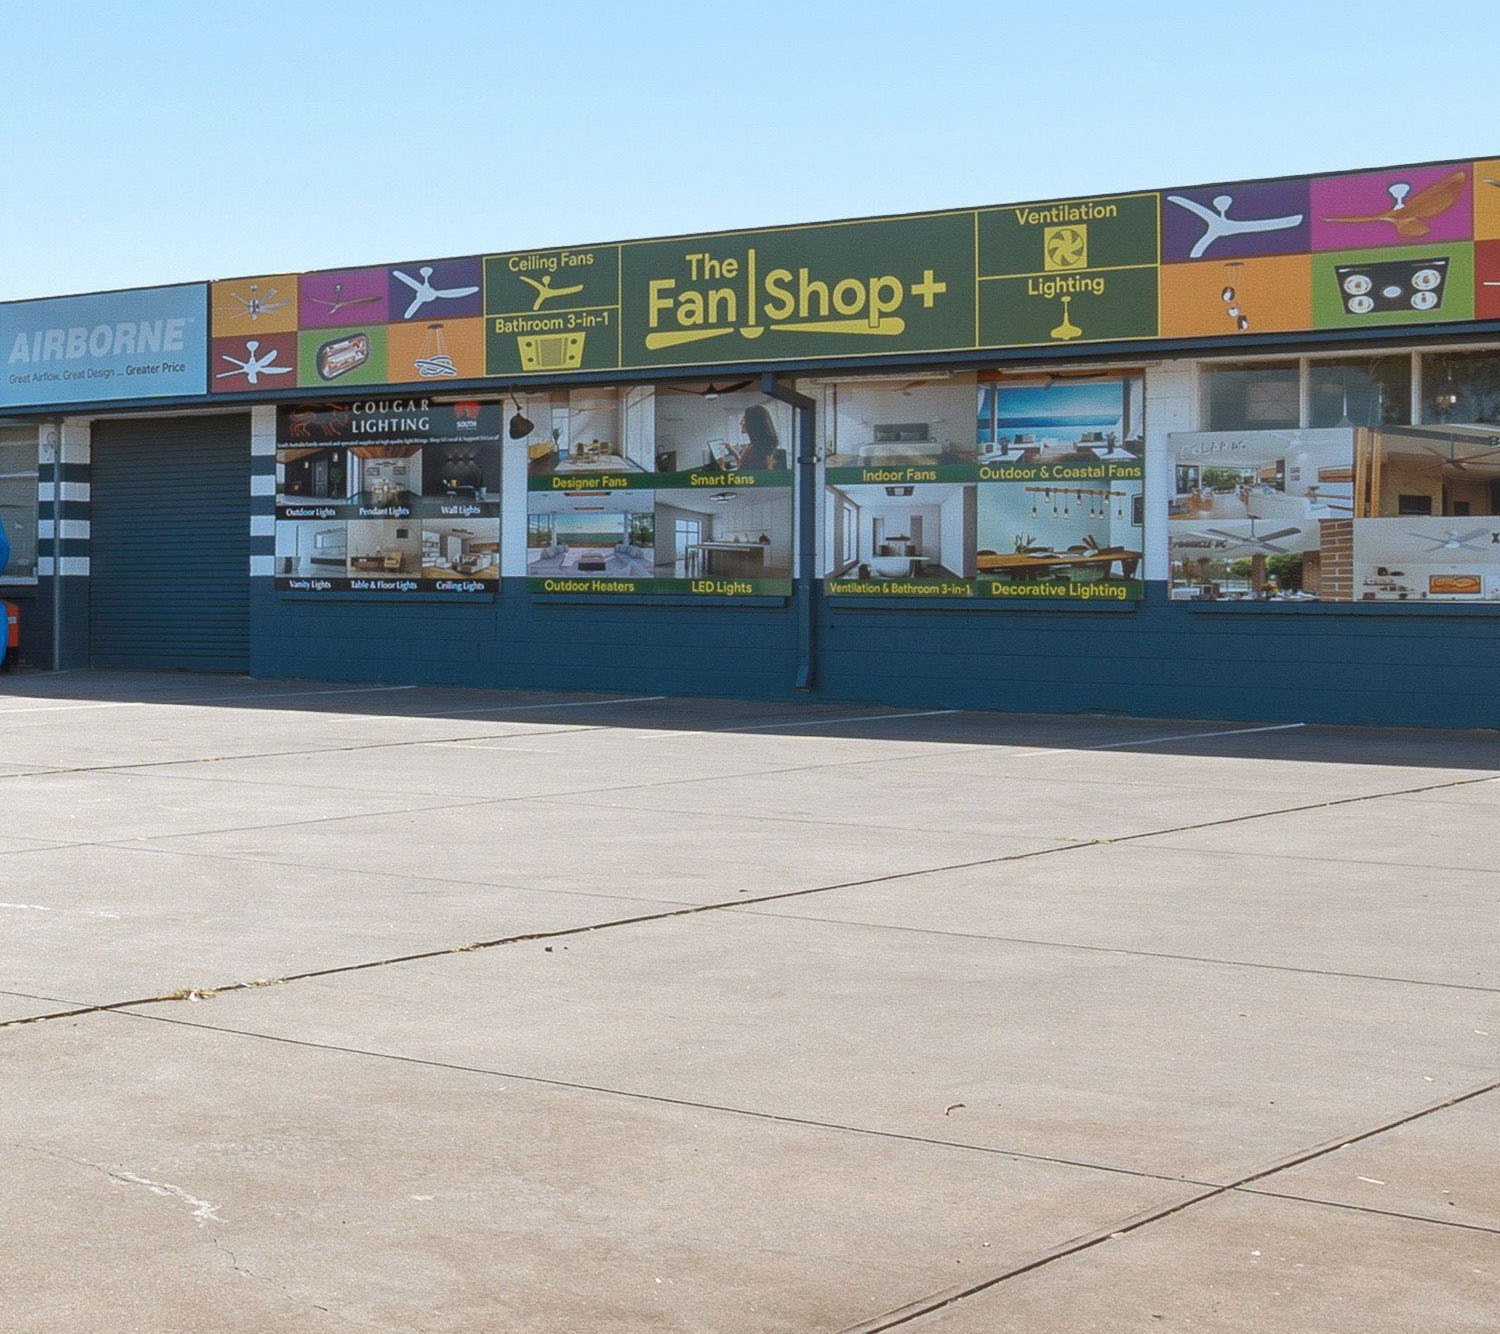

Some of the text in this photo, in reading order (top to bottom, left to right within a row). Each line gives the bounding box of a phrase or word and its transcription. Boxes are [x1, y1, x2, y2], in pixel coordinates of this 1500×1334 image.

[1015, 203, 1117, 225] Ventilation
[509, 253, 594, 272] Ceiling Fans
[685, 253, 738, 281] The
[1028, 275, 1105, 298] Lighting
[649, 279, 737, 327] Fan
[495, 312, 609, 333] Bathroom 3-in-1
[8, 317, 186, 364] AIRBORNE
[9, 373, 31, 384] Great
[63, 370, 85, 381] Great
[87, 368, 114, 381] Design
[126, 364, 159, 375] Greater
[162, 362, 185, 373] Price
[352, 399, 429, 414] COUGAR
[352, 417, 429, 433] LIGHTING
[863, 469, 936, 481] Indoor Fans
[979, 465, 1141, 479] Outdoor & Coastal Fans
[553, 476, 628, 490] Designer Fans
[691, 473, 755, 486] Smart Fans
[286, 508, 336, 517] Outdoor Lights
[359, 507, 410, 517] Pendant Lights
[441, 506, 481, 516] Wall Lights
[289, 581, 332, 591] Vanity Lights
[350, 581, 369, 589] Table
[377, 581, 396, 589] Floor
[397, 581, 417, 590] Lights
[436, 581, 485, 591] Ceiling Lights
[544, 580, 635, 592] Outdoor Heaters
[692, 581, 752, 596] LED Lights
[830, 582, 971, 595] Ventilation & Bathroom 3-in-1
[992, 582, 1127, 599] Decorative Lighting
